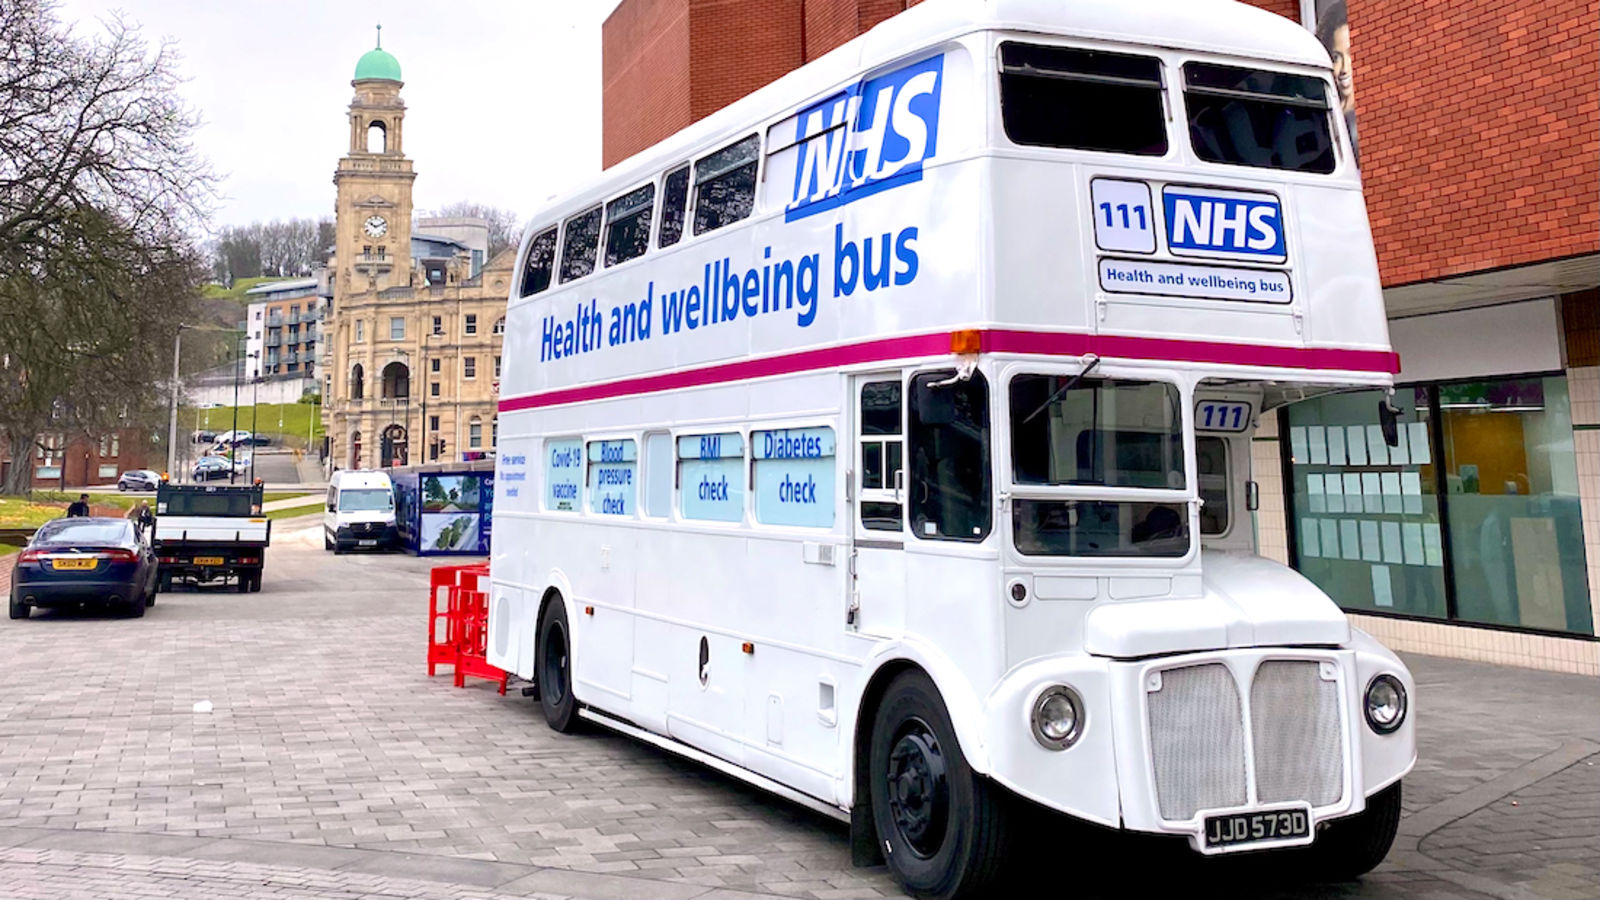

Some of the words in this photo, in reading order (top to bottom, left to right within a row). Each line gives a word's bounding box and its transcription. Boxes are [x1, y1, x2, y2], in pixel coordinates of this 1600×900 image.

[789, 70, 939, 209] NHS
[1099, 202, 1147, 230] 111
[1172, 199, 1277, 250] NHS
[540, 303, 601, 363] Health
[609, 281, 653, 347] and
[661, 246, 820, 327] wellbeing
[833, 223, 919, 299] bus
[1107, 268, 1153, 284] Health
[1158, 273, 1184, 286] and
[1188, 275, 1256, 293] wellbeing
[1260, 279, 1284, 292] bus
[1203, 405, 1243, 428] 111
[552, 447, 581, 468] Covid-19
[601, 440, 623, 463] Blood
[700, 436, 721, 461] BMI
[764, 430, 822, 459] Diabetes
[552, 479, 577, 499] vaccine
[598, 468, 632, 490] pressure
[698, 474, 729, 501] check
[779, 473, 816, 503] check
[603, 492, 625, 515] check
[1208, 818, 1248, 843] JJD
[1252, 812, 1306, 838] 573D
